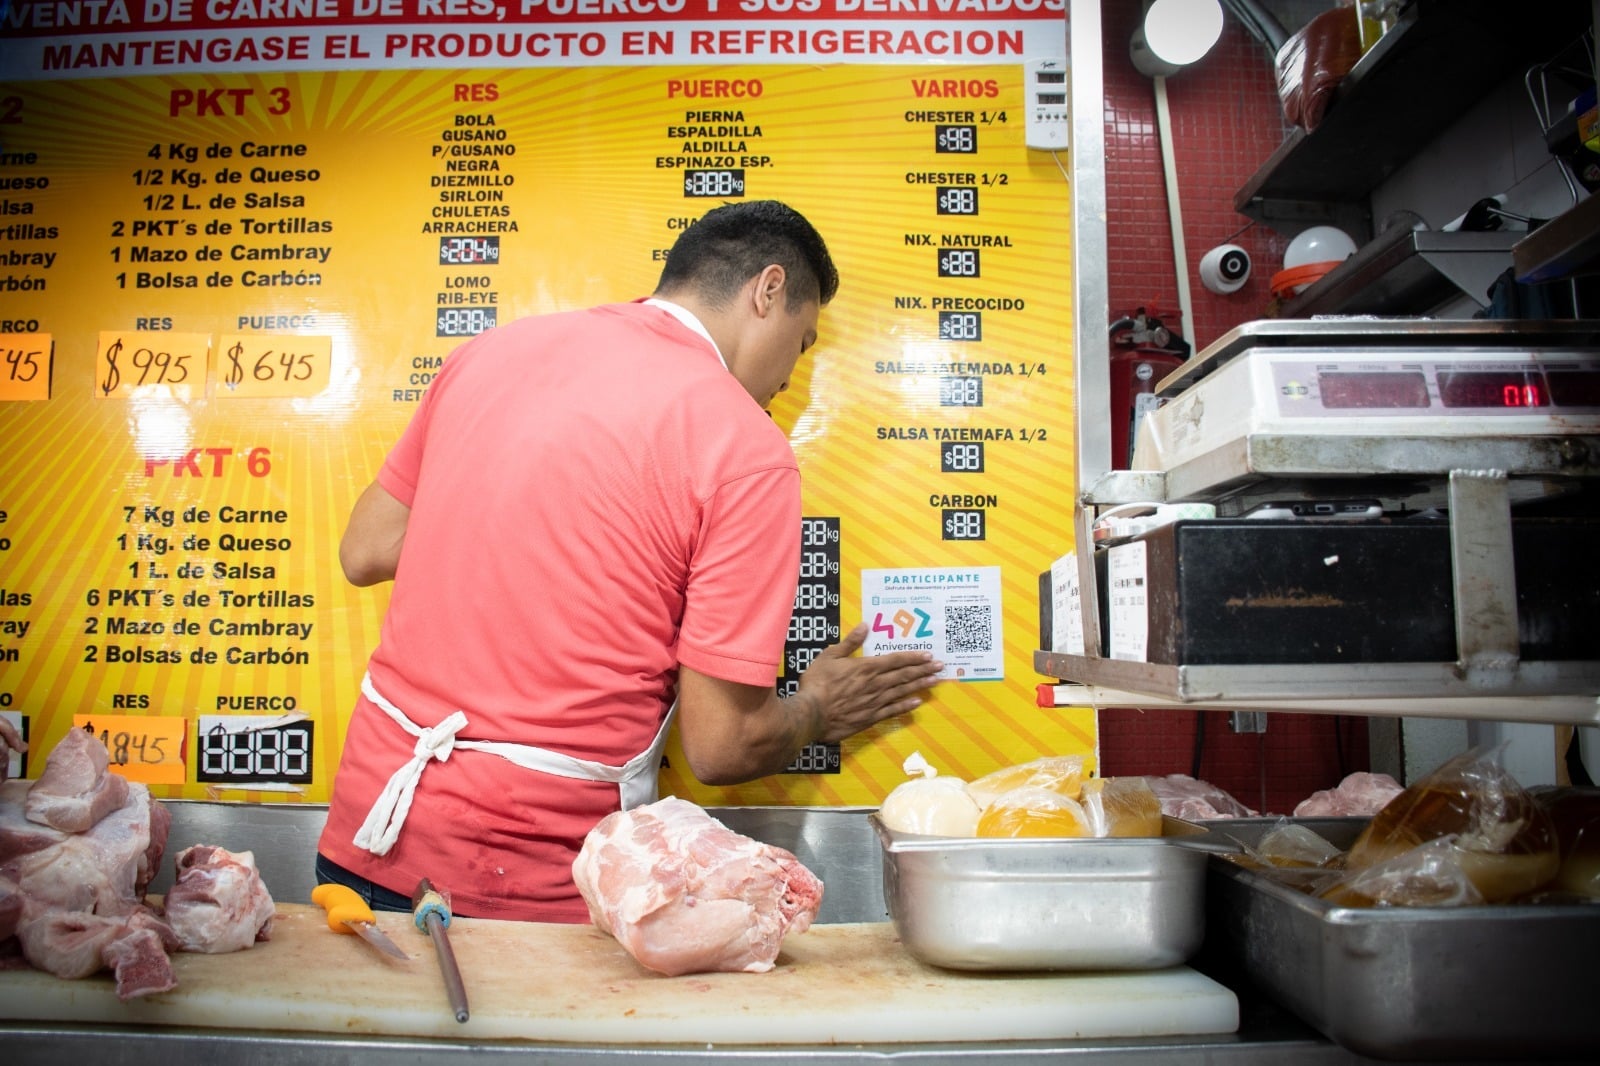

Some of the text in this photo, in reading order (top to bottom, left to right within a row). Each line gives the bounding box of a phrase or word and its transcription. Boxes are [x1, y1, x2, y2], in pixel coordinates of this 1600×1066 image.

[9, 0, 131, 29] VENTA
[144, 0, 193, 23] DE
[206, 0, 338, 21] CARNE
[42, 29, 1024, 70] MANTENGASE EL PRODUCTO EN REFRIGERACION
[454, 83, 499, 102] RES
[667, 79, 763, 98] PUERCO
[911, 79, 999, 98] VARIOS
[169, 87, 291, 117] PKT 3
[455, 115, 496, 126] BOLA
[685, 111, 745, 124] PIERNA
[904, 111, 1008, 126] CHESTER 1/4
[442, 129, 507, 142] GUSANO
[667, 126, 763, 139] ESPALDILLA
[148, 142, 308, 163] 4 Kg de Carne
[432, 144, 516, 158] P/GUSANO
[682, 141, 748, 154] ALDILLA
[446, 160, 500, 172] NEGRA
[655, 156, 775, 169] ESPINAZO ESP.
[132, 167, 321, 188] 1/2 Kg. de Queso
[431, 175, 515, 188] DIEZMILLO
[905, 172, 1009, 188] CHESTER 1/2
[143, 192, 306, 212] 1/2 L. de Salsa
[439, 190, 504, 203] SIRLOIN
[432, 206, 511, 219] CHULETAS
[111, 221, 125, 237] 2
[205, 219, 233, 235] de
[240, 217, 334, 234] Tortillas
[422, 221, 519, 234] ARRACHERA
[904, 234, 1013, 248] NIX. NATURAL
[111, 244, 332, 263] 1 Mazo de Cambray
[116, 270, 322, 289] 1 Bolsa de Carbón
[445, 276, 491, 289] LOMO
[437, 292, 499, 305] RIB-EYE
[894, 297, 1025, 311] NIX. PRECOCIDO
[136, 317, 172, 330] RES
[238, 316, 316, 330] PUERCO
[1018, 363, 1046, 378] 1/4
[876, 427, 1047, 443] SALSA TATEMAFA 1/2
[145, 447, 271, 478] PKT 6
[929, 494, 998, 507] CARBON
[123, 506, 288, 527] 7 Kg de Carne
[117, 534, 292, 555] 1 Kg. de Queso
[129, 562, 276, 579] 1 L. de Salsa
[884, 574, 980, 583] PARTICIPANTE
[86, 589, 100, 606] 6
[183, 590, 211, 607] de
[219, 590, 315, 607] Tortillas
[84, 617, 314, 640] 2 Mazo de Cambray
[872, 607, 934, 640] 492
[874, 641, 933, 651] Aniversario
[83, 645, 309, 665] 2 Bolsas de Carbón
[113, 695, 150, 708] RES
[216, 697, 297, 710] PUERCO
